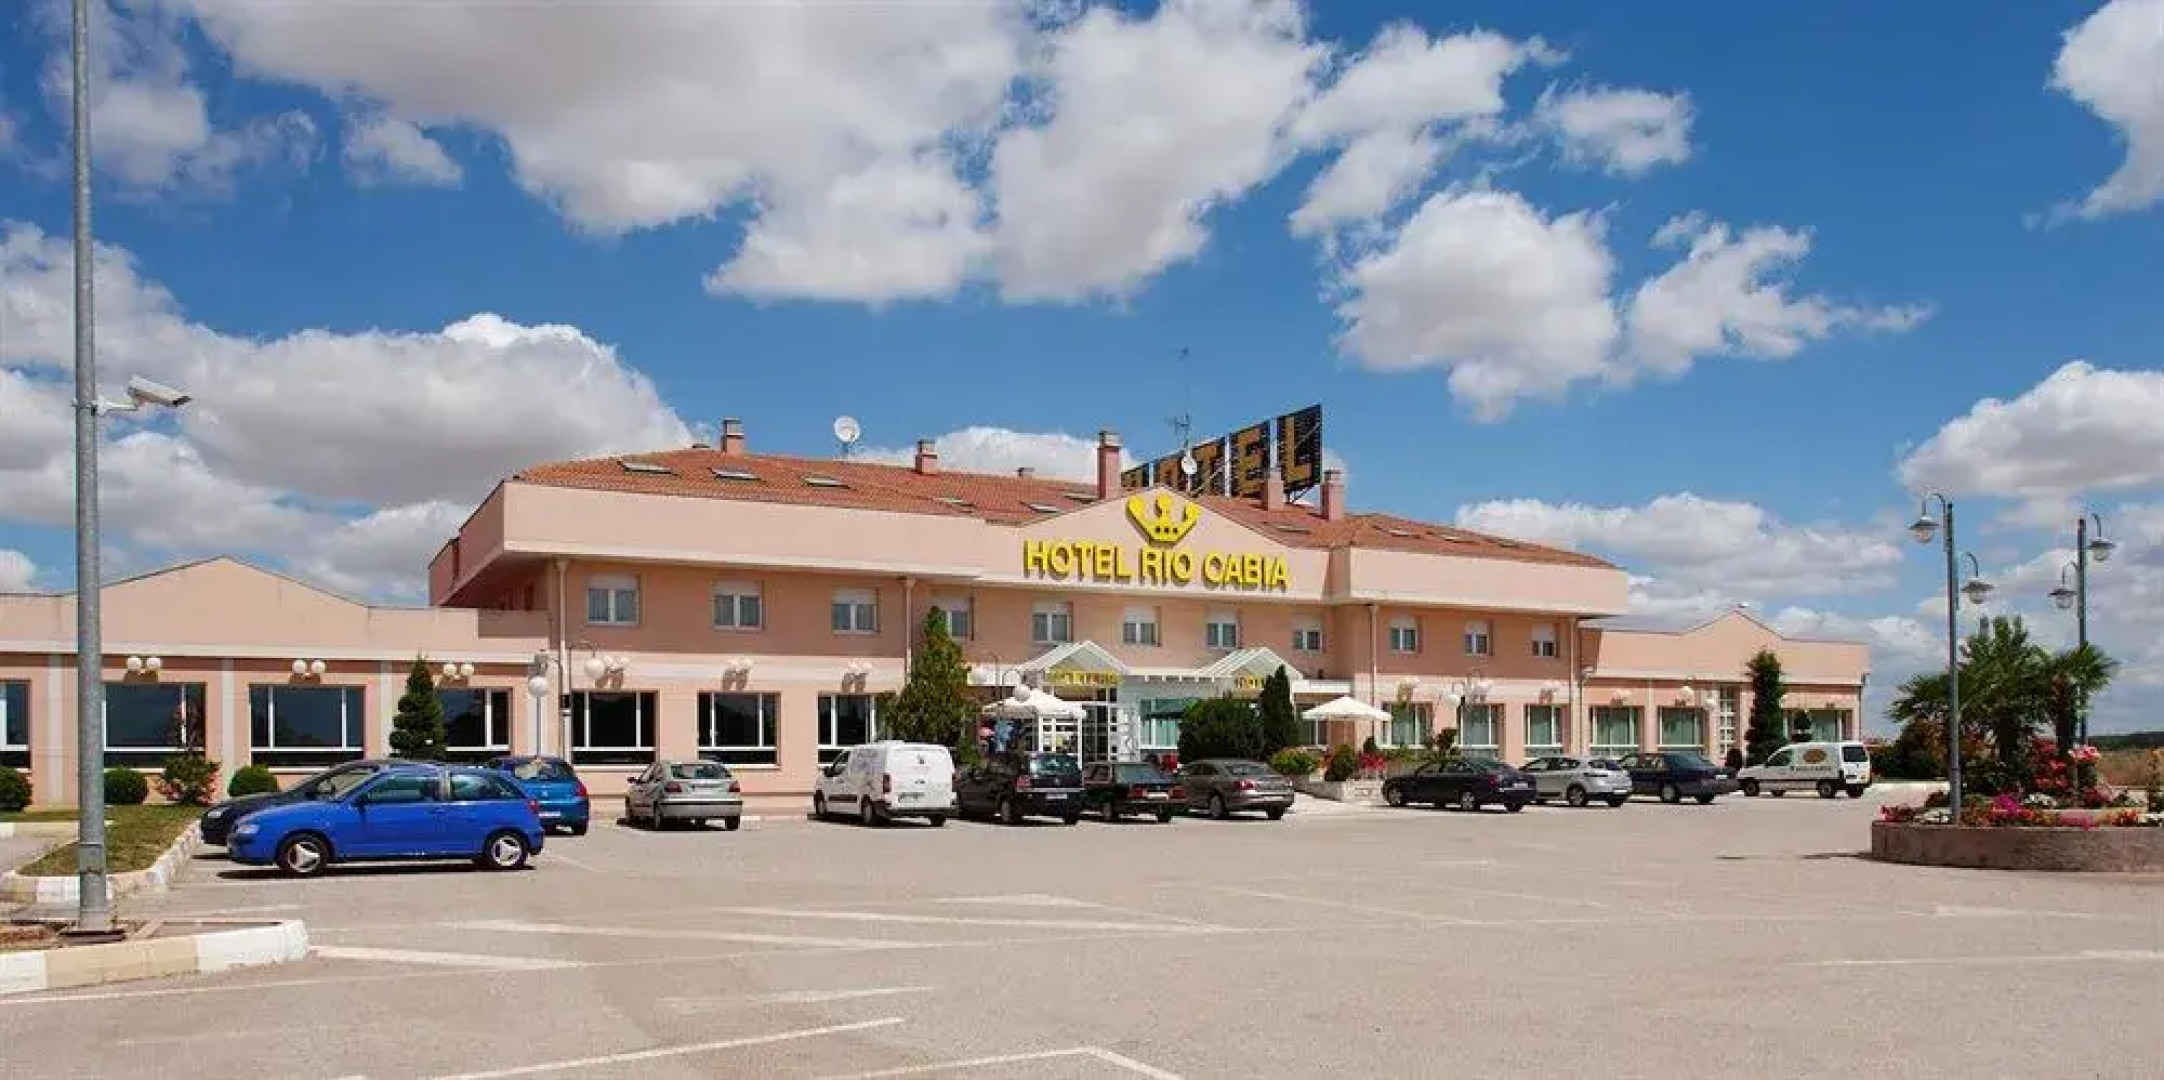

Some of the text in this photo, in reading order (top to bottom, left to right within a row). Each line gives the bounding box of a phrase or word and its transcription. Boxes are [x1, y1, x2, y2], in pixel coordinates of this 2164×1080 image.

[1024, 539, 1291, 590] HOTEL RIO CABIA
